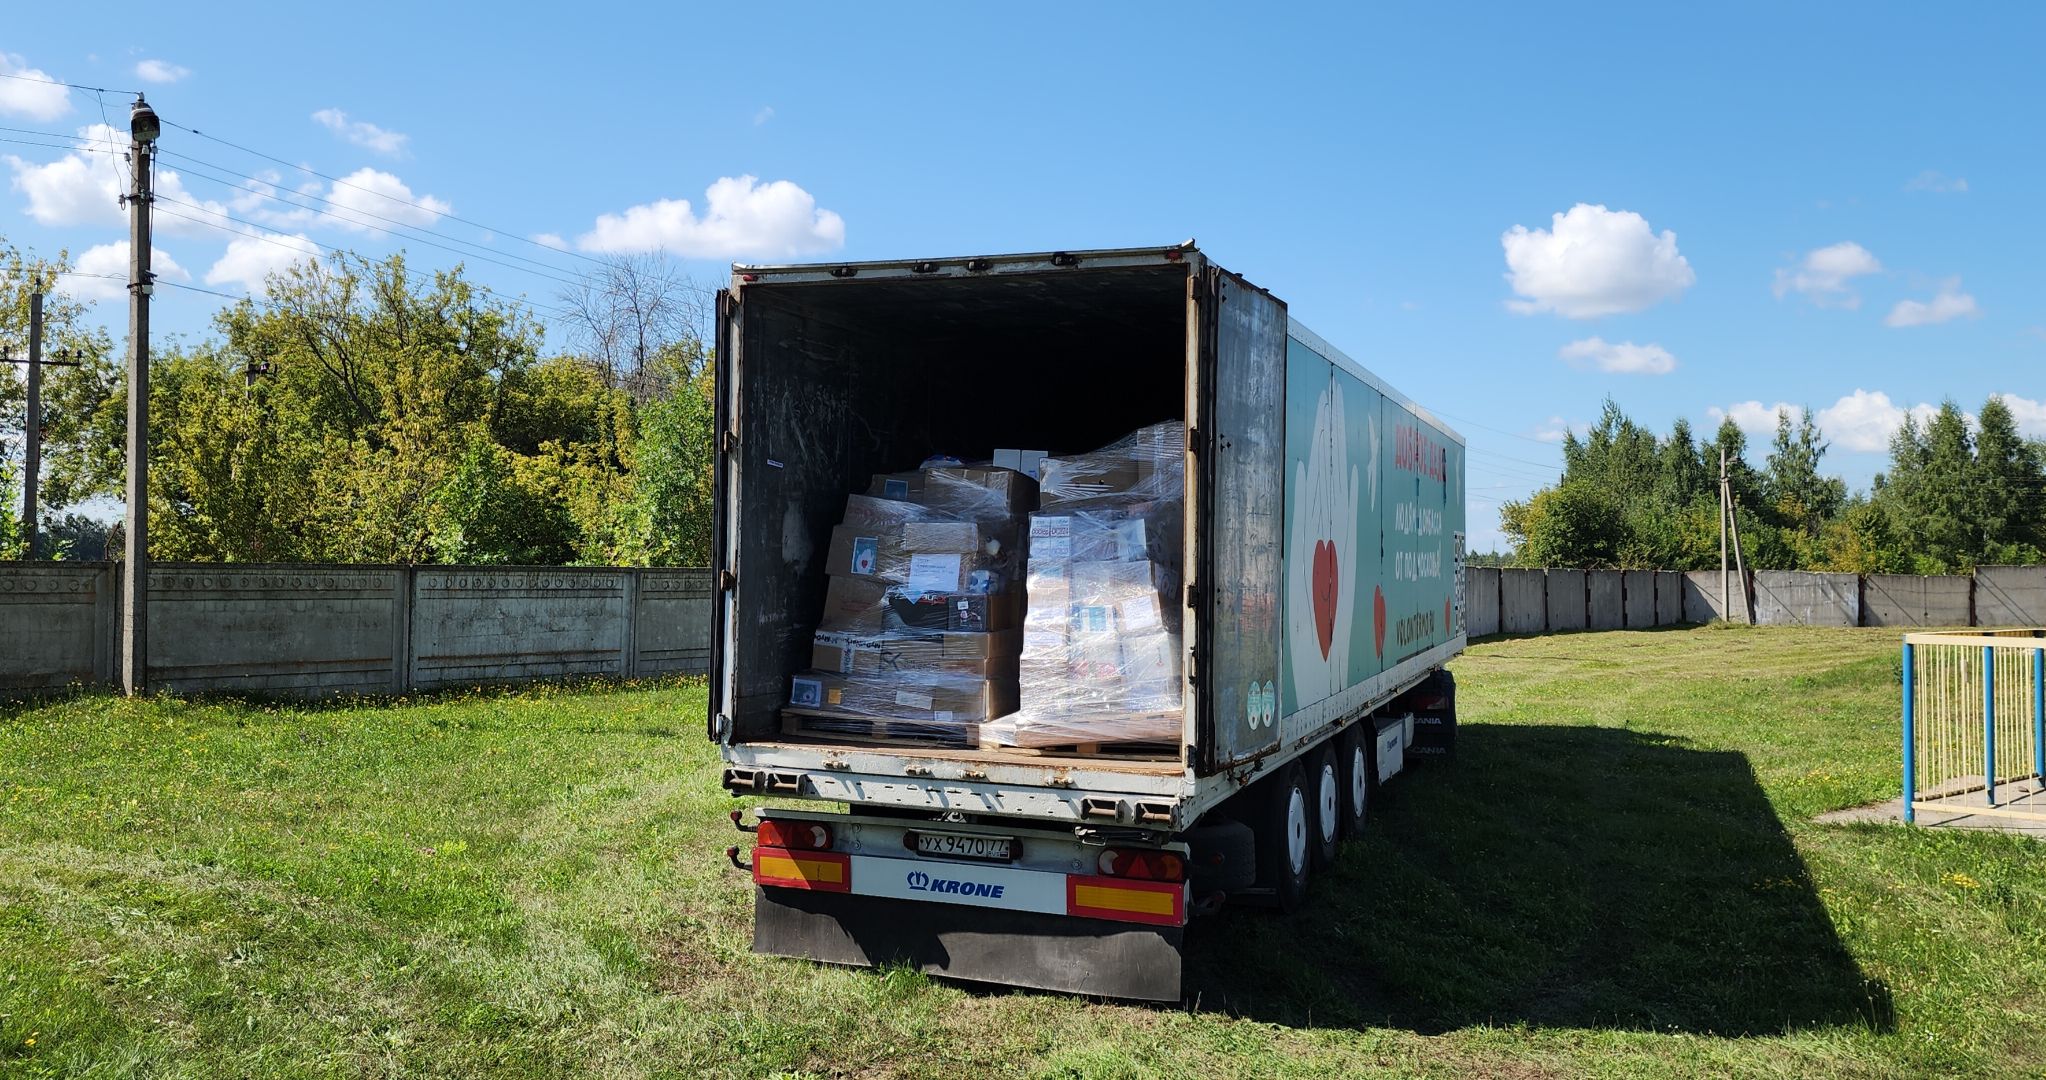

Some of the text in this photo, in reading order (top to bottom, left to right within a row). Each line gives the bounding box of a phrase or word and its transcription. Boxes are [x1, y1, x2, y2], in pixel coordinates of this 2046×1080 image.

[1395, 424, 1427, 475] ДОБРОЕ
[1395, 501, 1417, 535] ЛЮДЯМ
[1395, 551, 1403, 582] ОТ
[947, 835, 984, 855] 9470
[990, 838, 1005, 851] 77
[930, 879, 1005, 899] KRONE
